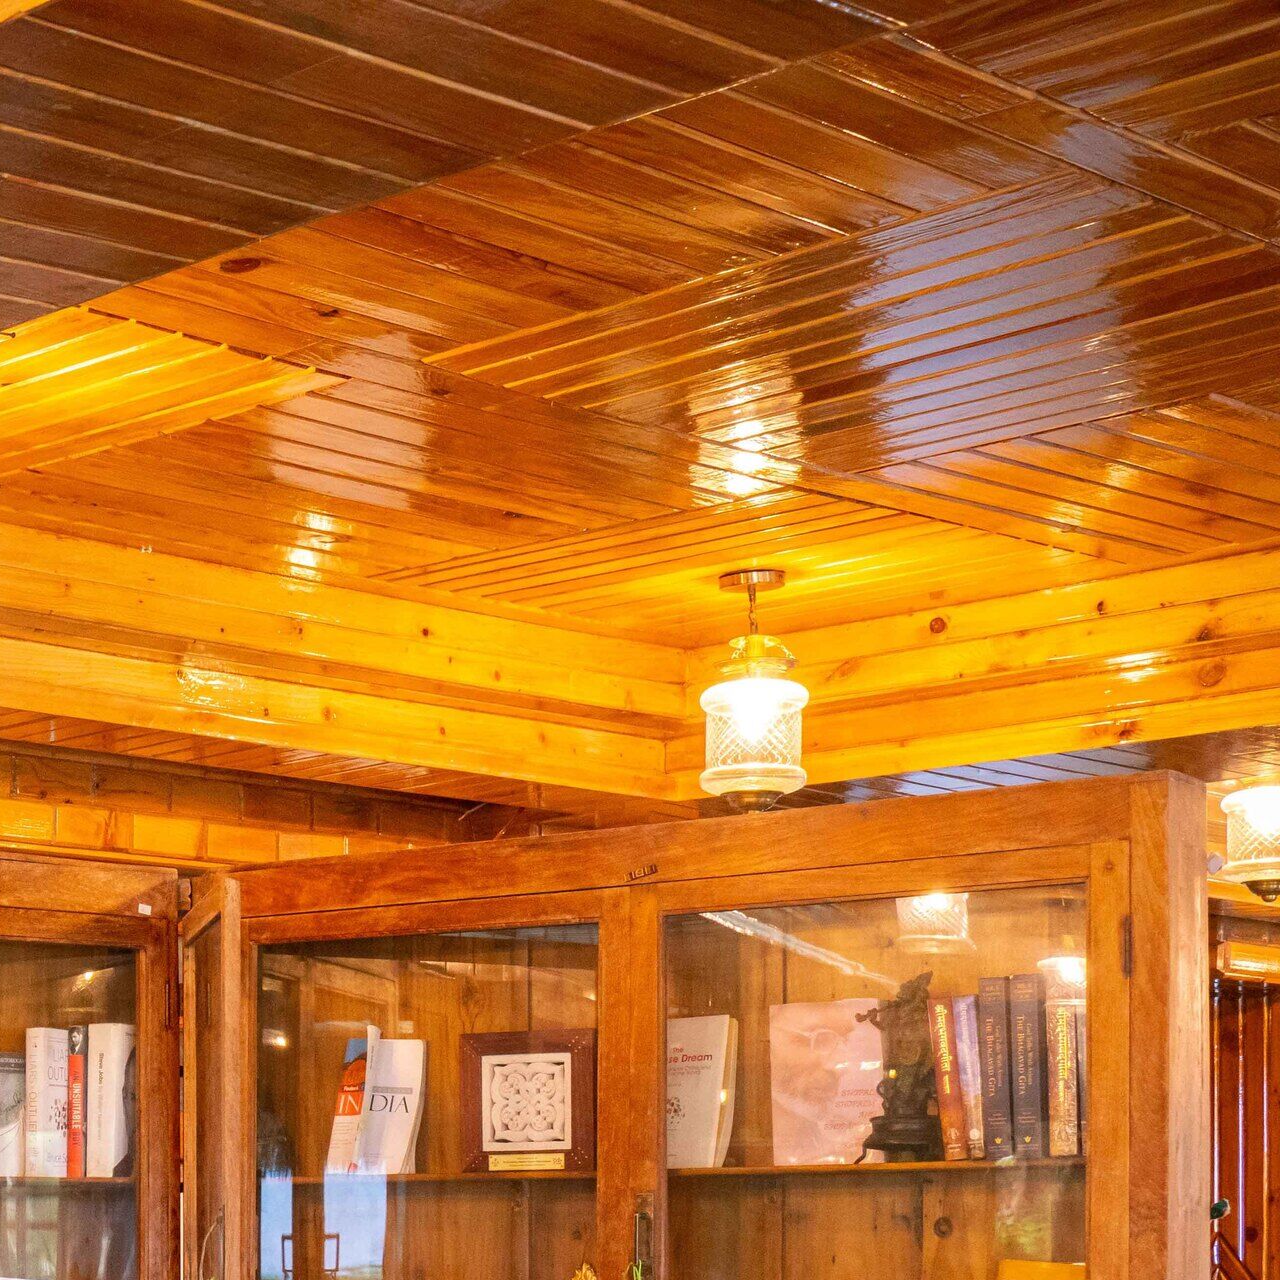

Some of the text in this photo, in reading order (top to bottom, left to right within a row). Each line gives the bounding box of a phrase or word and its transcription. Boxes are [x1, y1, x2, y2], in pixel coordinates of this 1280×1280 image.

[681, 1053, 713, 1063] Dream
[1017, 1032, 1025, 1074] BHAGAVAD
[48, 1067, 68, 1081] OUTL
[72, 1083, 81, 1129] UNSUITABLE
